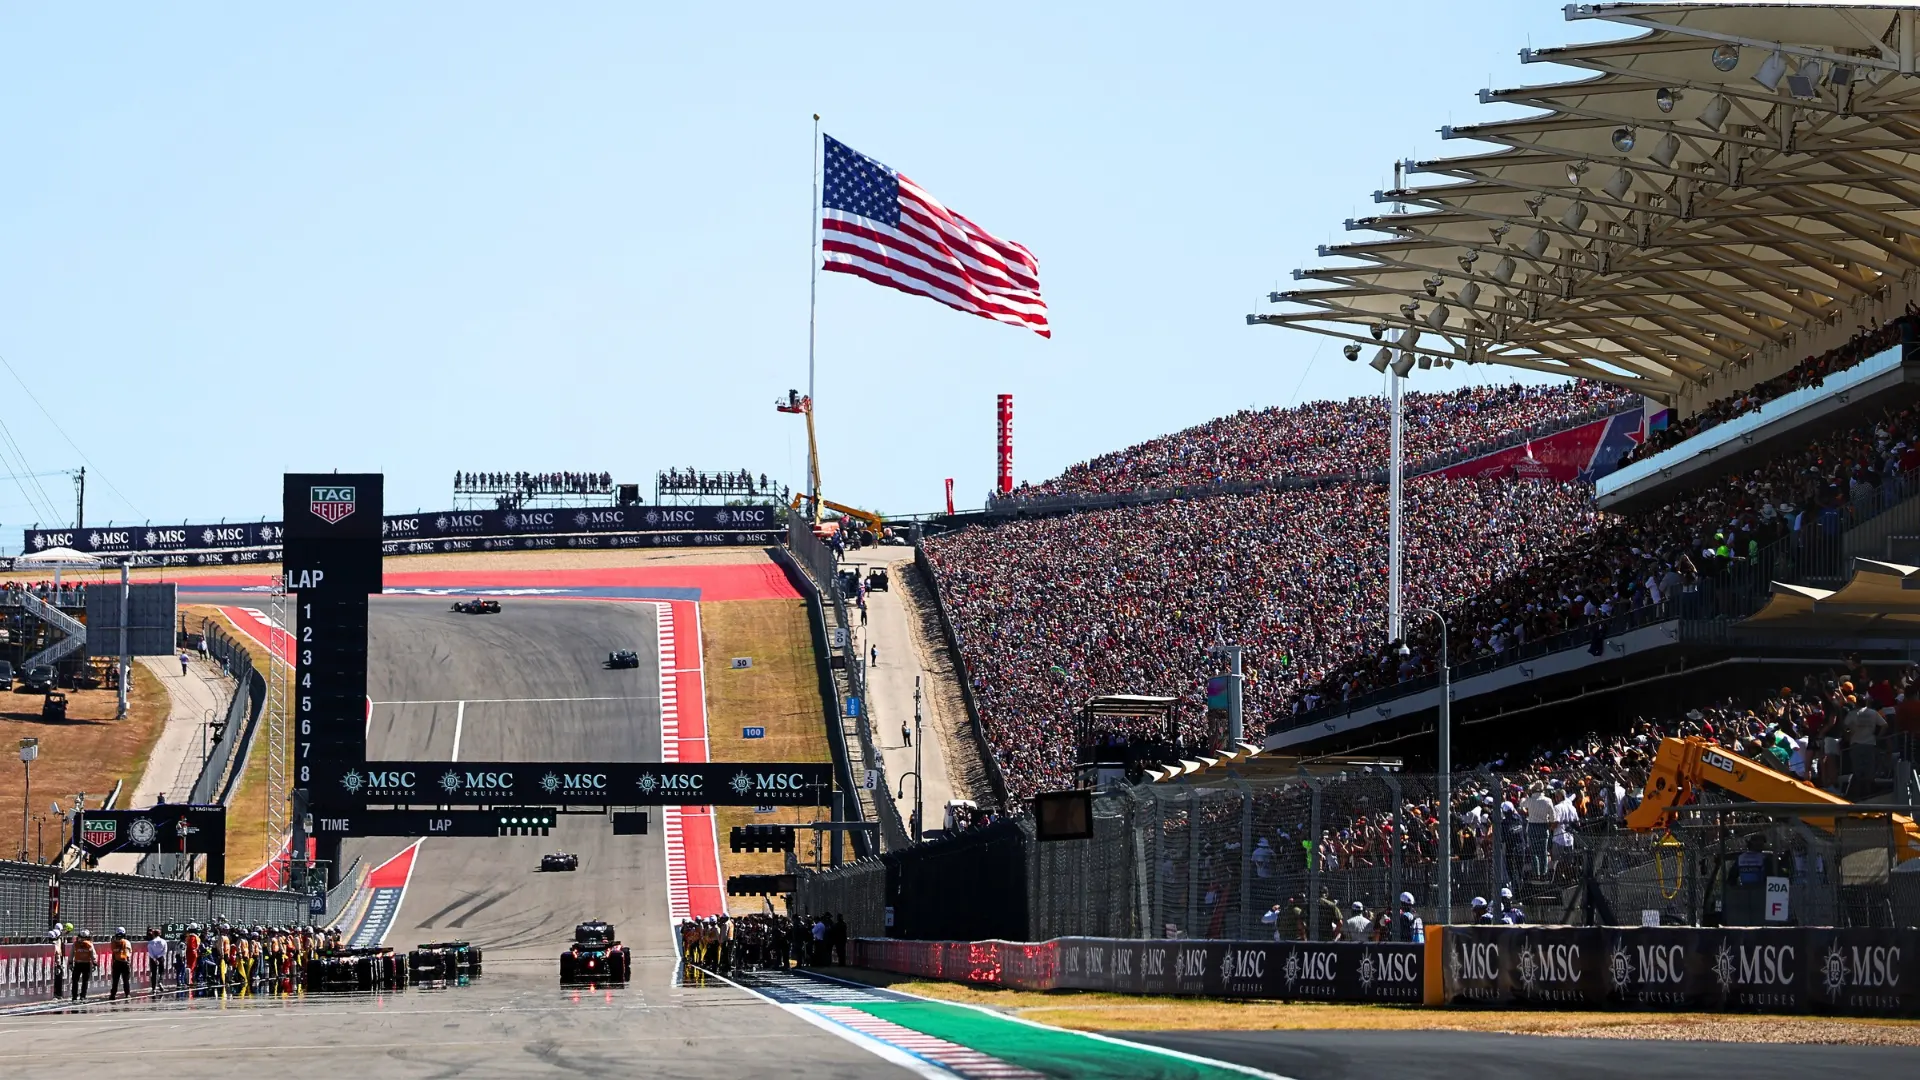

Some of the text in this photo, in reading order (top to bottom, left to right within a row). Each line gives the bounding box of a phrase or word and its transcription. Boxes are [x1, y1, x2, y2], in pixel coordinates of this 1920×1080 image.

[315, 489, 351, 500] TAG
[313, 504, 352, 520] HEUER
[521, 513, 554, 525] MSC
[592, 511, 624, 522] MSC
[662, 510, 694, 522] MSC
[732, 510, 764, 522] MSC
[391, 518, 419, 531] MSC
[451, 515, 483, 527] MSC
[46, 533, 73, 546] MSC
[102, 532, 129, 544] MSC
[159, 530, 186, 542] MSC
[216, 528, 244, 540] MSC
[620, 536, 640, 544] MSC
[416, 542, 434, 550] MSC
[536, 538, 556, 546] MSC
[206, 554, 222, 562] MSC
[240, 552, 258, 560] MSC
[288, 570, 324, 588] LAP
[304, 604, 310, 618] 1
[303, 626, 312, 642] 2
[302, 650, 312, 666] 3
[302, 673, 312, 688] 4
[302, 696, 312, 712] 5
[302, 720, 311, 735] 6
[746, 728, 760, 736] 100
[302, 742, 310, 758] 7
[1702, 752, 1734, 772] JCB
[300, 766, 310, 782] 8
[368, 772, 416, 788] MSC
[465, 772, 513, 788] MSC
[563, 774, 606, 788] MSC
[866, 771, 874, 788] 150
[661, 774, 703, 789] MSC
[756, 774, 804, 790] MSC
[87, 822, 114, 830] TAG
[320, 819, 349, 831] TIME
[430, 819, 452, 831] LAP
[84, 832, 114, 846] HEUER
[1768, 883, 1788, 892] 20A
[1772, 903, 1782, 916] F
[1117, 948, 1132, 976] MSC
[1148, 948, 1166, 976] MSC
[1184, 950, 1207, 976] MSC
[1235, 950, 1266, 978] MSC
[1301, 952, 1338, 980] MSC
[1378, 953, 1417, 982] MSC
[1462, 943, 1498, 980] MSC
[1538, 944, 1581, 982] MSC
[1637, 944, 1684, 983] MSC
[1738, 946, 1794, 984] MSC
[1852, 946, 1900, 987] MSC
[1376, 988, 1418, 996] CRUISES
